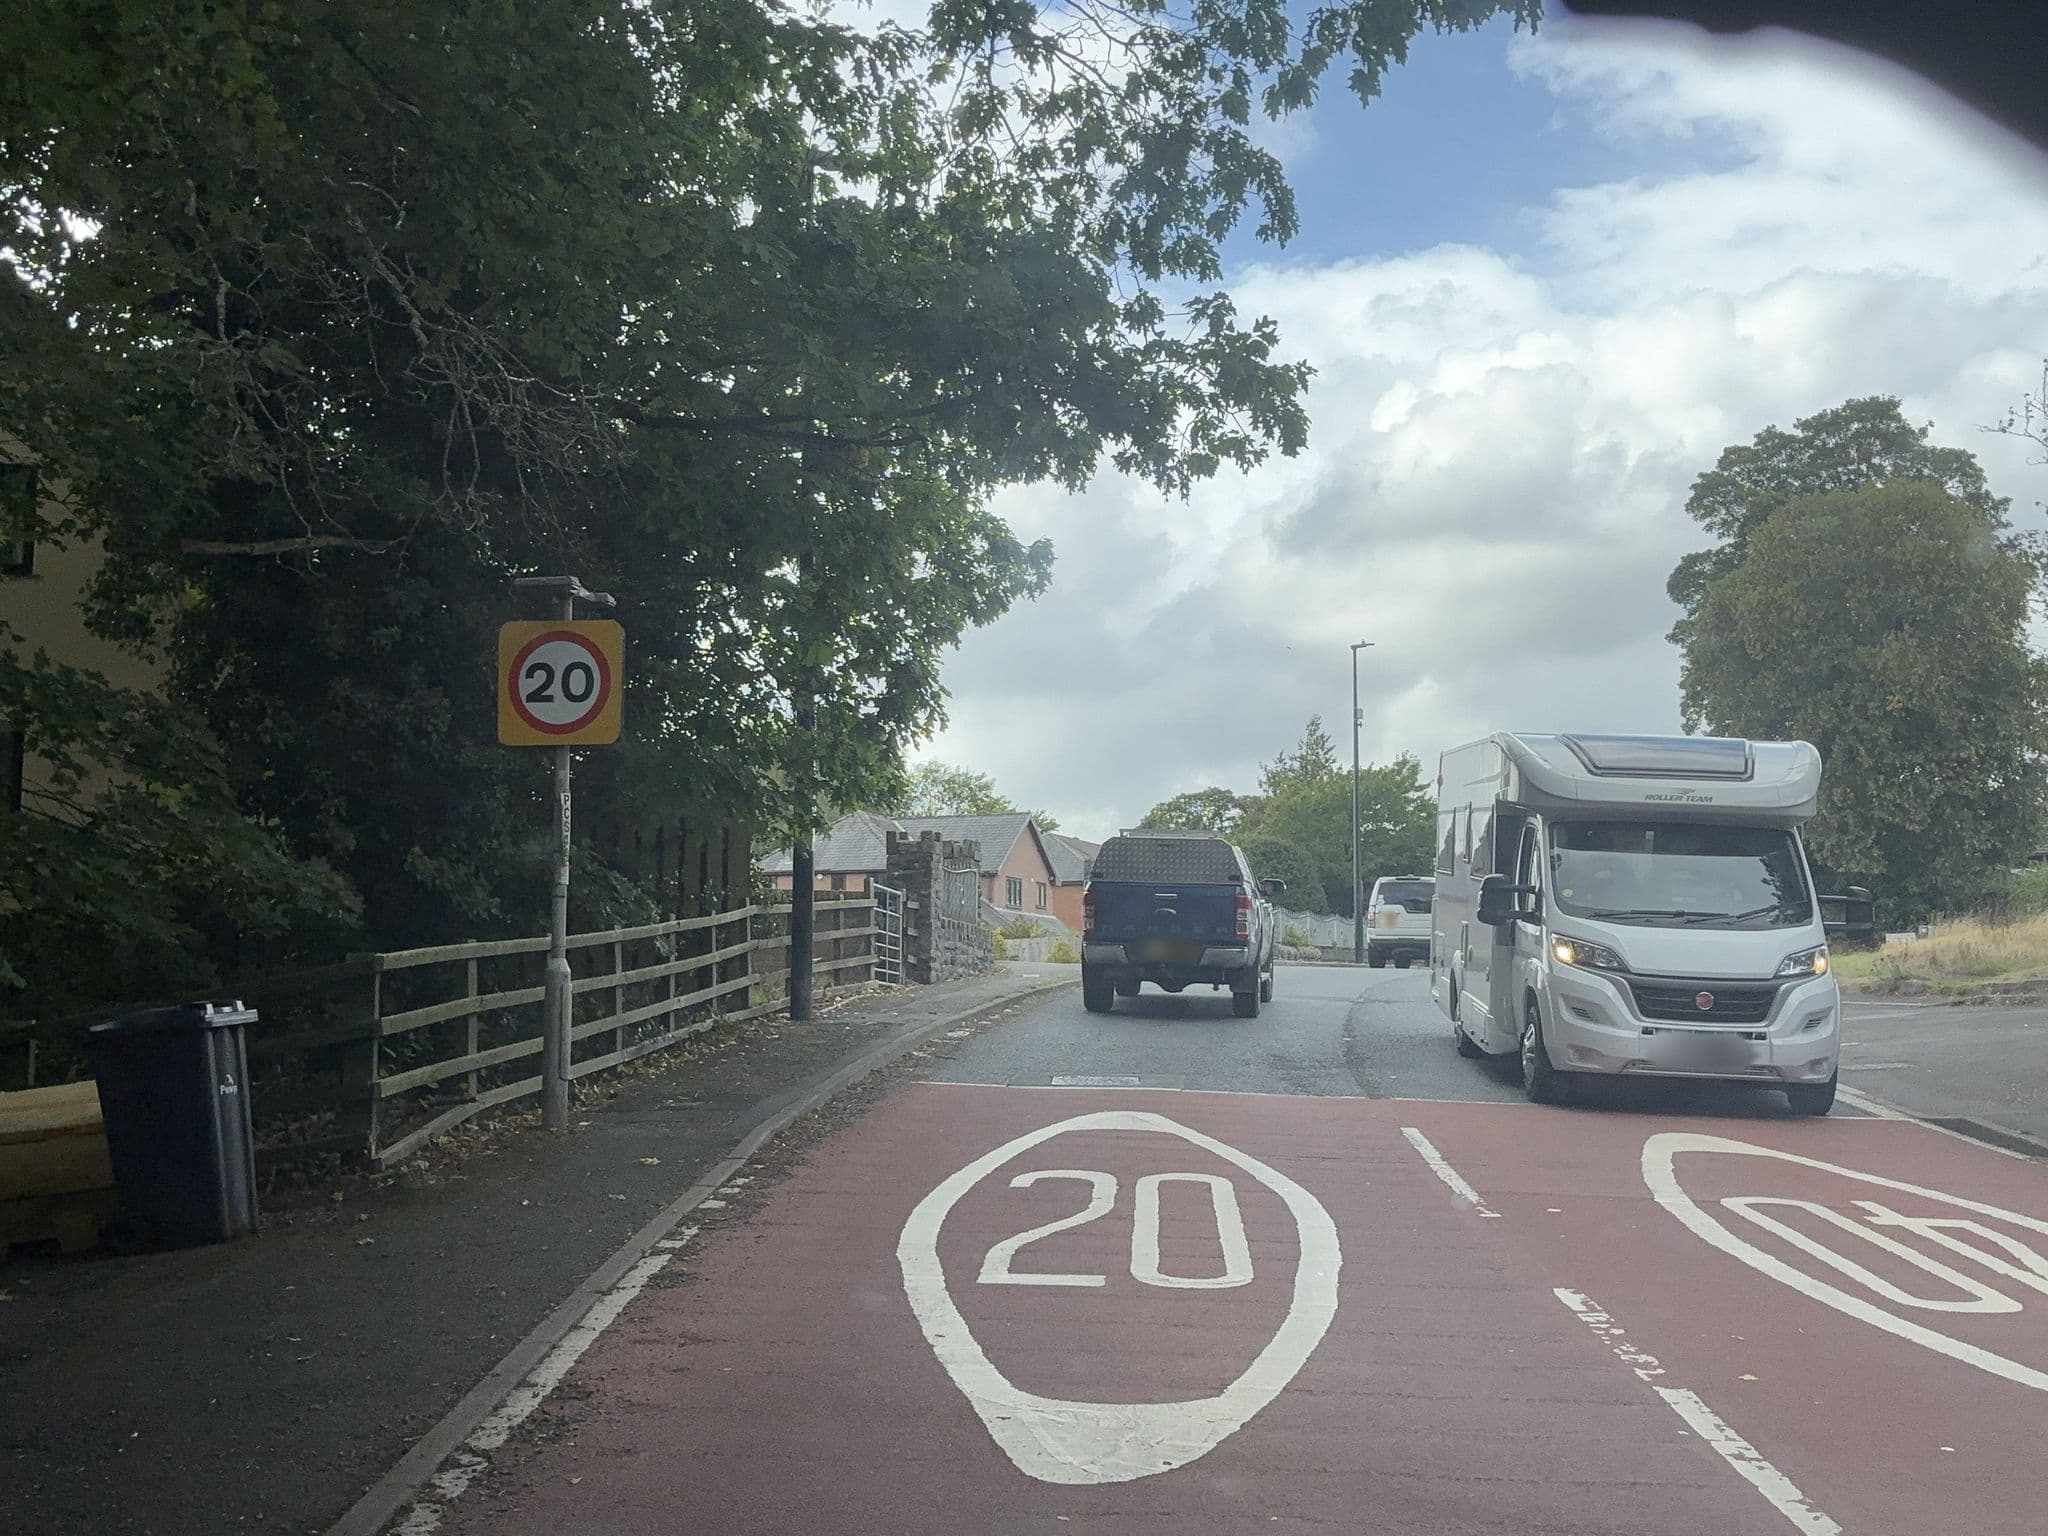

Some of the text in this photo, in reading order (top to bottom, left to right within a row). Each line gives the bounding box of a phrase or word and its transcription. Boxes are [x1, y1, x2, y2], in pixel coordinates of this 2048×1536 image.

[525, 661, 594, 703] 20
[1644, 793, 1713, 804] ROLLER TEAM
[976, 1169, 1253, 1289] 20
